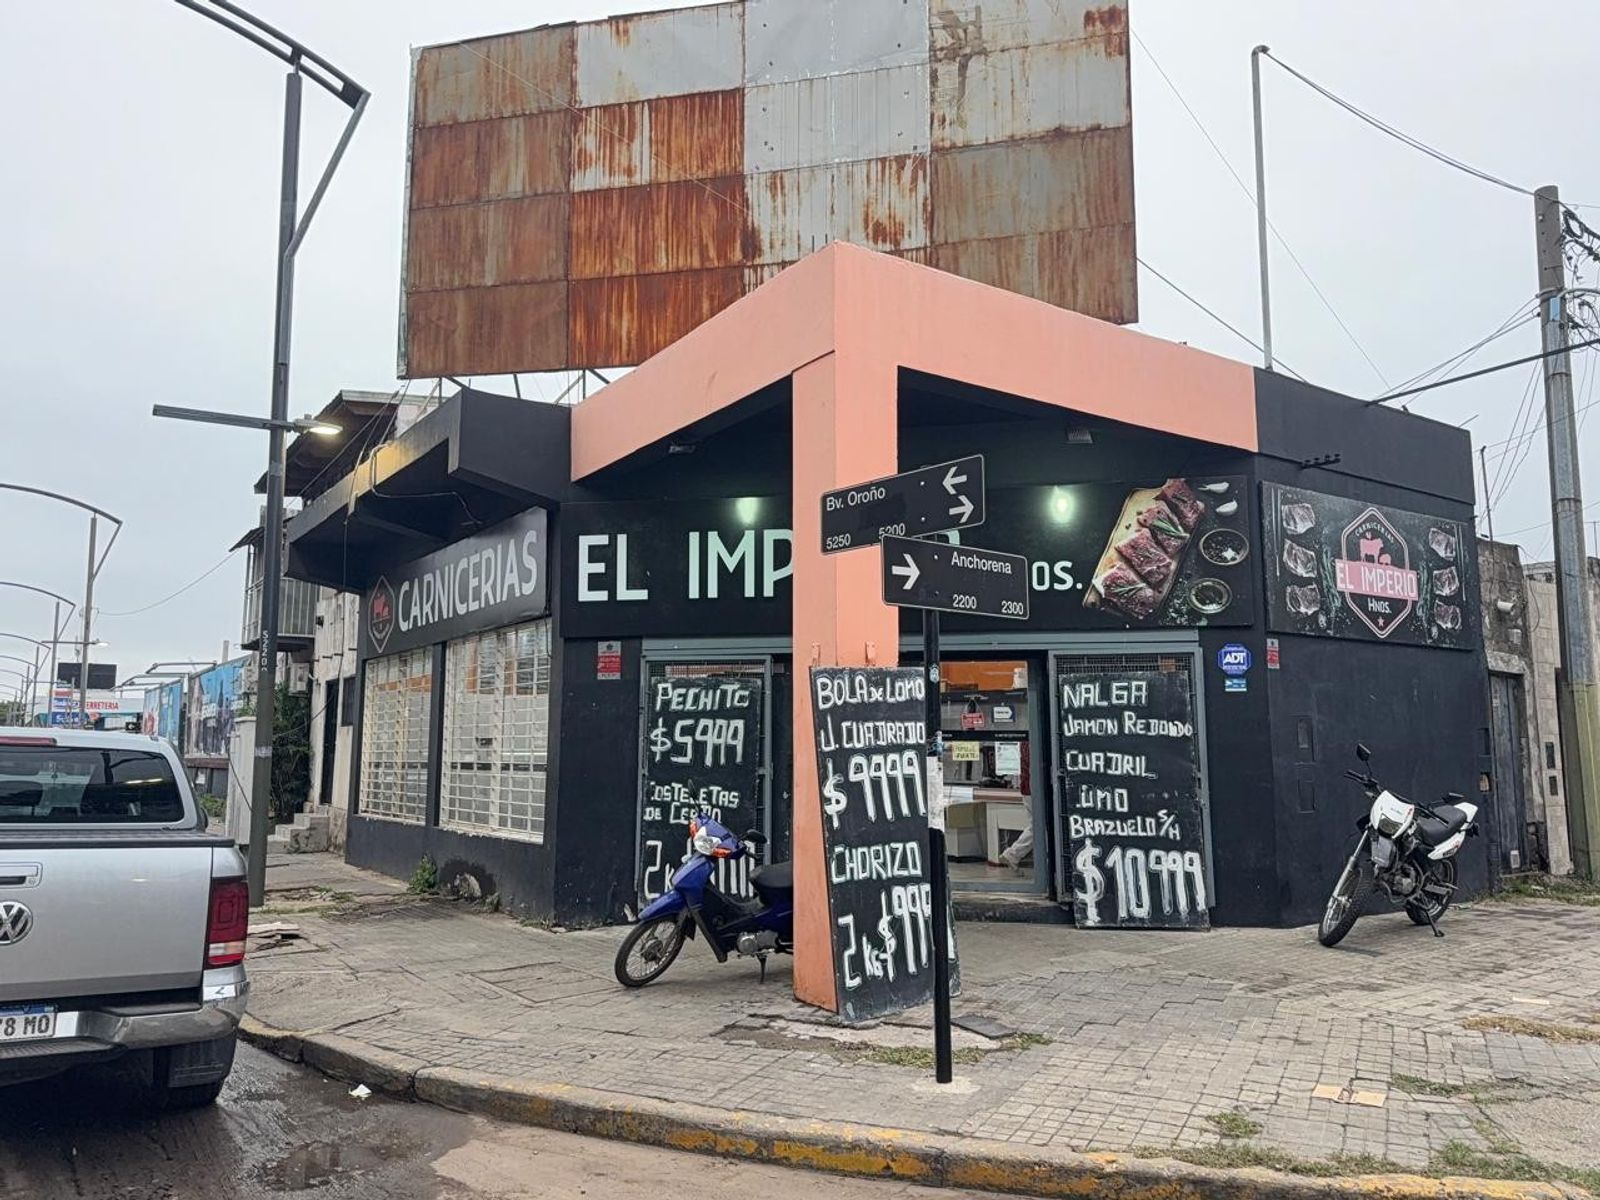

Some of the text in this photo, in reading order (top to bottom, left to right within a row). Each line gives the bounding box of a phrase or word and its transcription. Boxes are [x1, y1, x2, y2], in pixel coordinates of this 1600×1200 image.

[825, 486, 886, 512] Bv. Oroño
[825, 533, 852, 549] 5250
[578, 533, 649, 602] EL
[688, 529, 794, 599] IMP
[951, 551, 1012, 575] Anchorena
[399, 530, 538, 632] CARNICERIAS
[1335, 560, 1418, 598] EL IMPERIO
[952, 594, 1024, 616] 2200 2300
[1223, 652, 1246, 664] ADT
[86, 702, 119, 710] ERRETERIA
[655, 683, 750, 712] PECHITO
[816, 675, 868, 710] BOLA
[885, 677, 926, 703] LOMO
[1063, 681, 1147, 708] NALGA
[841, 720, 926, 748] CUADRADO
[1064, 711, 1193, 737] JAMON REDONDO
[650, 717, 745, 768] $5999
[1066, 751, 1158, 779] CUADRIL
[823, 749, 928, 830] $9999
[643, 807, 661, 821] DE
[1069, 815, 1156, 839] BRAZUELO
[831, 841, 922, 884] CHORIZO
[1075, 838, 1207, 926] $10999
[0, 1017, 16, 1036] 8
